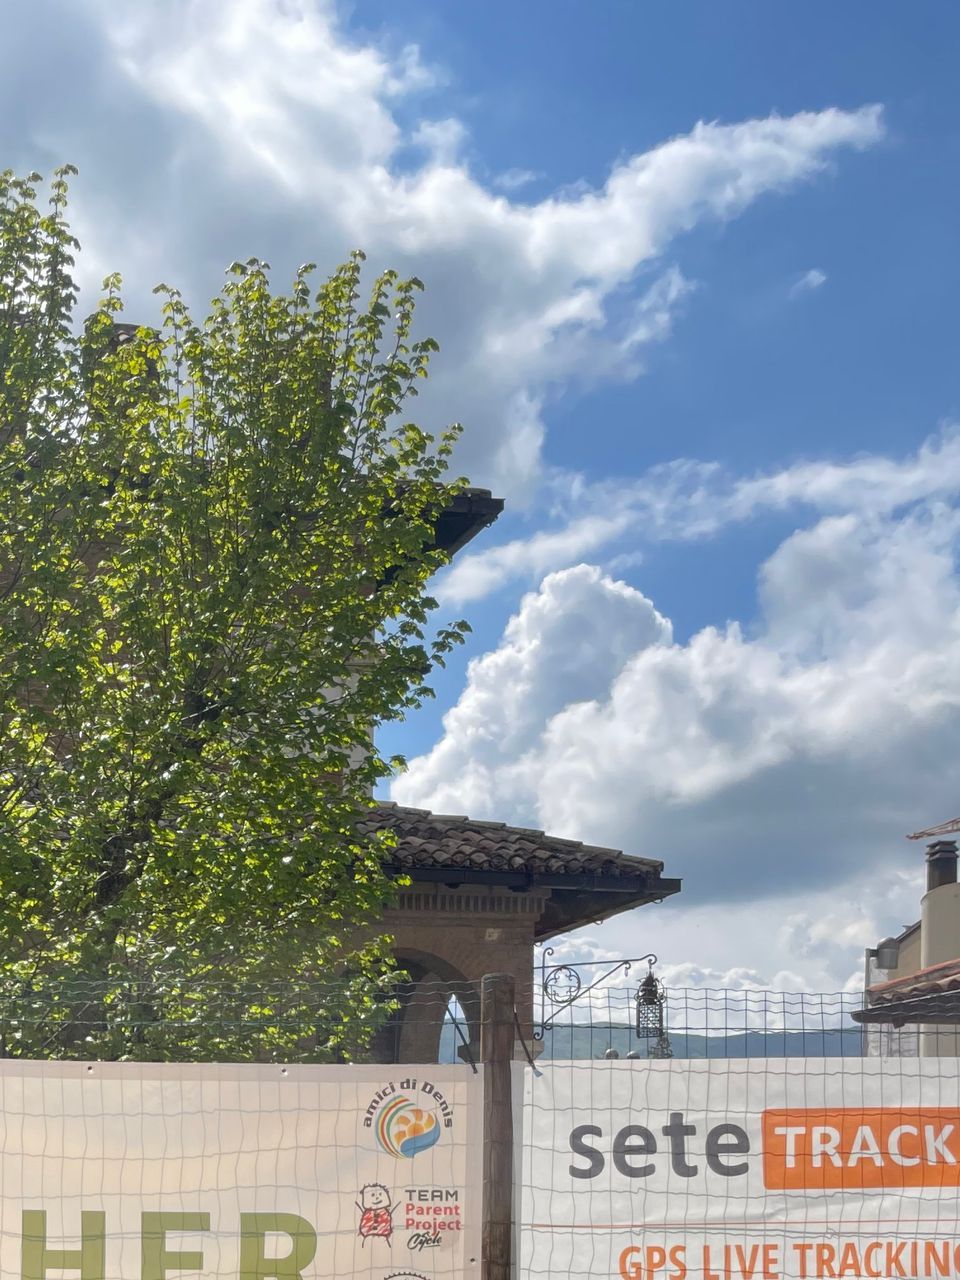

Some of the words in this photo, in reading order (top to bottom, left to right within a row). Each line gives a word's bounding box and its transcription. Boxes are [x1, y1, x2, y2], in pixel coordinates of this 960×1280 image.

[363, 1082, 396, 1128] amici
[400, 1078, 417, 1090] di
[420, 1080, 454, 1128] Denis
[774, 1124, 957, 1168] TRACK
[405, 1189, 458, 1201] TEAM
[405, 1203, 461, 1215] Parent
[405, 1217, 461, 1236] Project
[703, 1244, 780, 1280] LIVE
